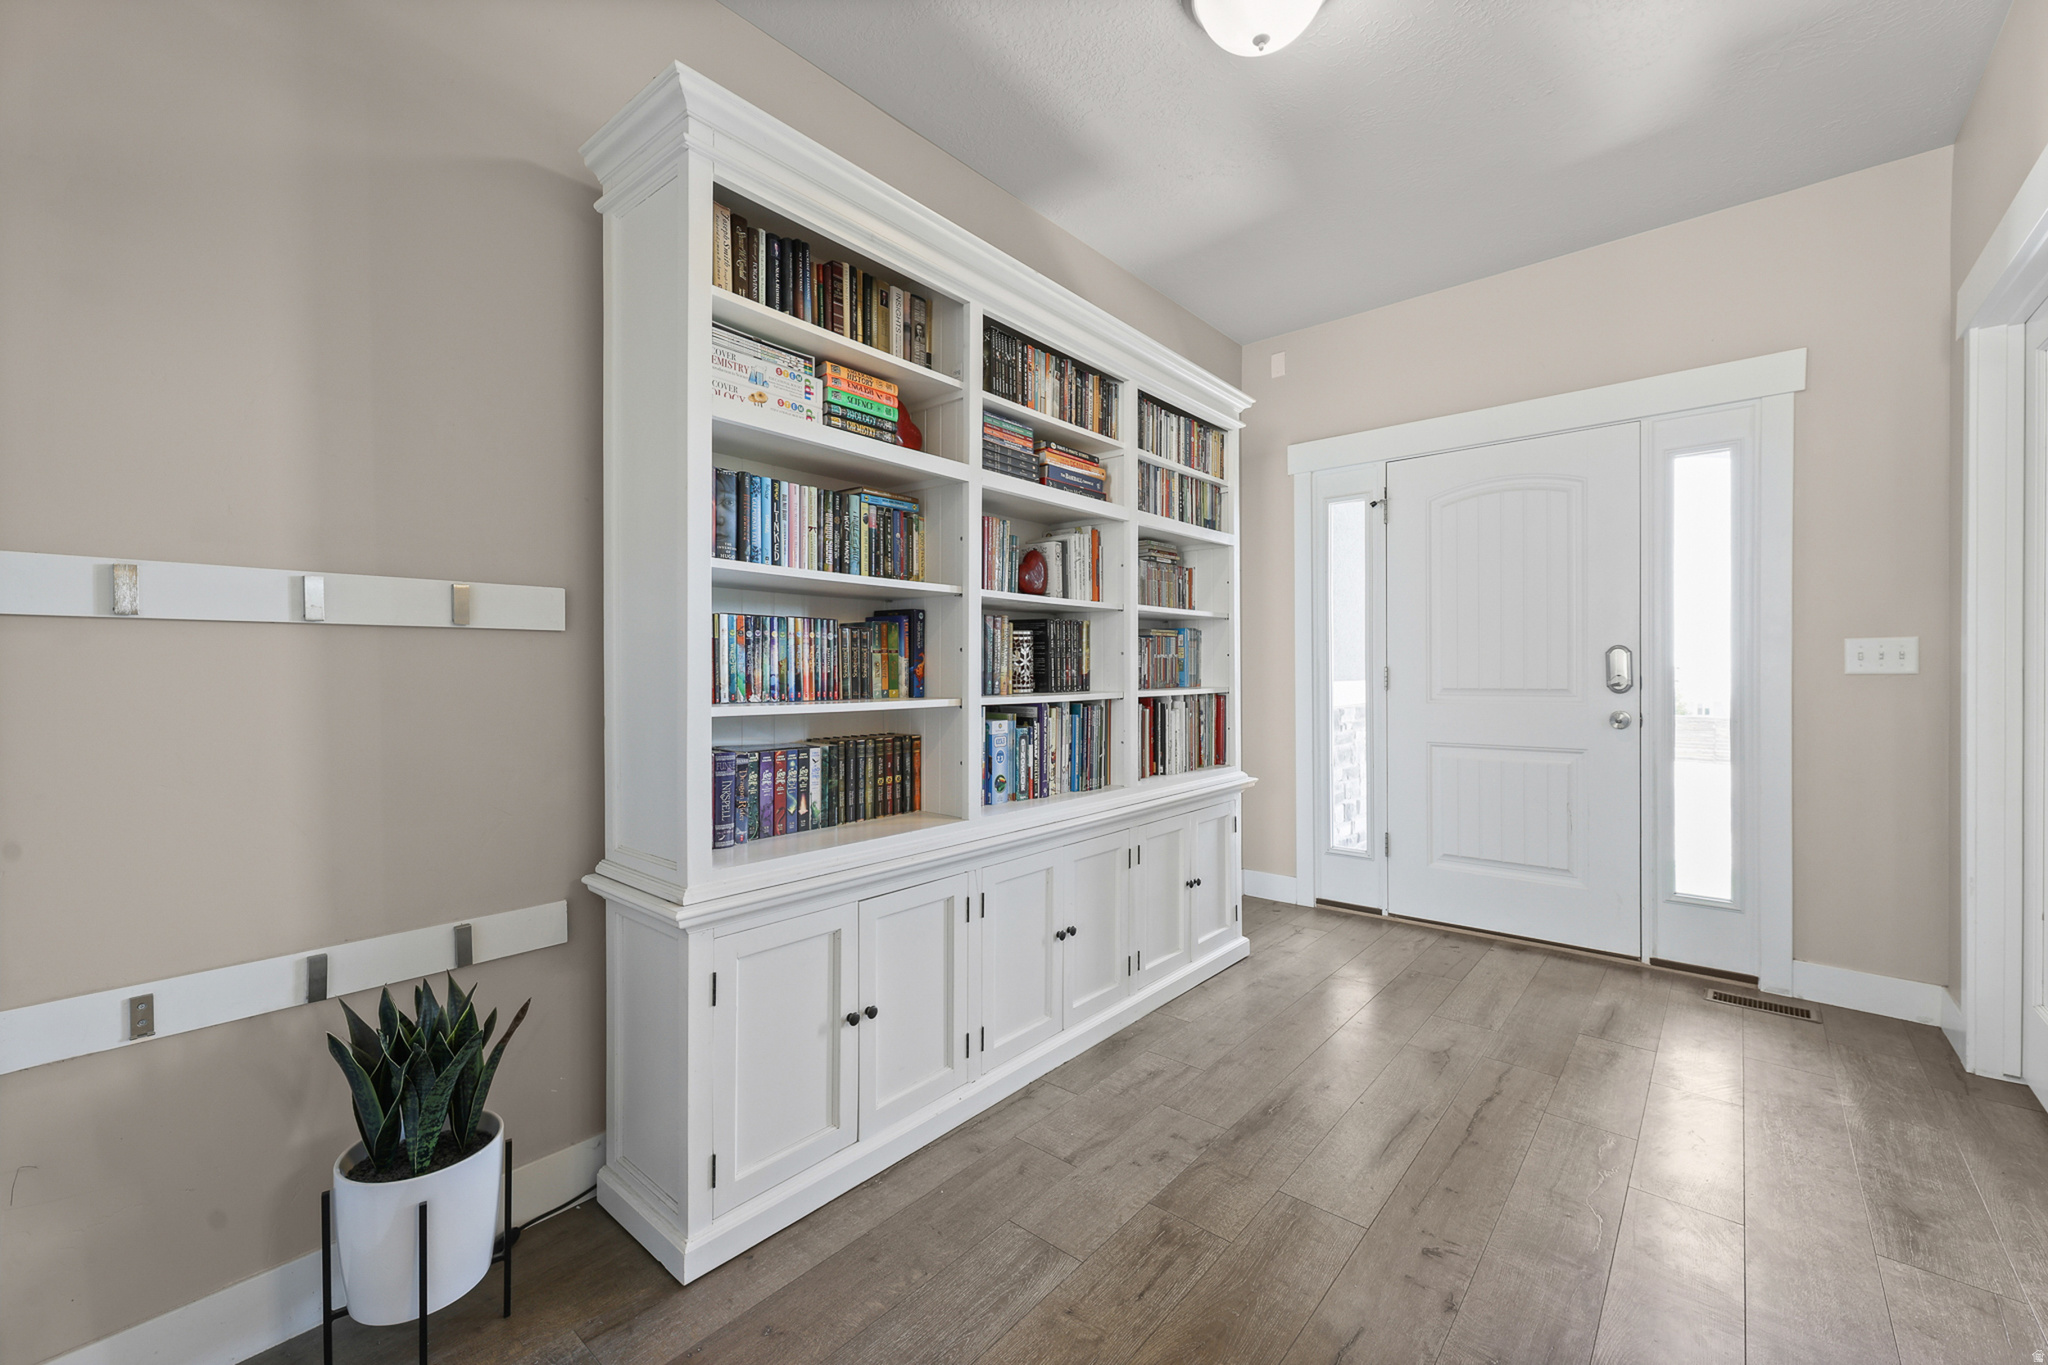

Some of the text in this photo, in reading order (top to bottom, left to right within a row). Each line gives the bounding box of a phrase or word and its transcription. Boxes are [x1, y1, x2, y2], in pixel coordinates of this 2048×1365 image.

[721, 211, 730, 240] Joseph
[723, 240, 731, 268] Smith
[711, 379, 739, 394] COVER
[846, 373, 874, 388] HISTORY
[847, 380, 875, 396] ENGLISH
[847, 395, 874, 410] SCIENCE
[846, 409, 877, 426] BIOLOGY
[719, 780, 733, 822] INKSPELL
[737, 767, 748, 822] Dragon Rider
